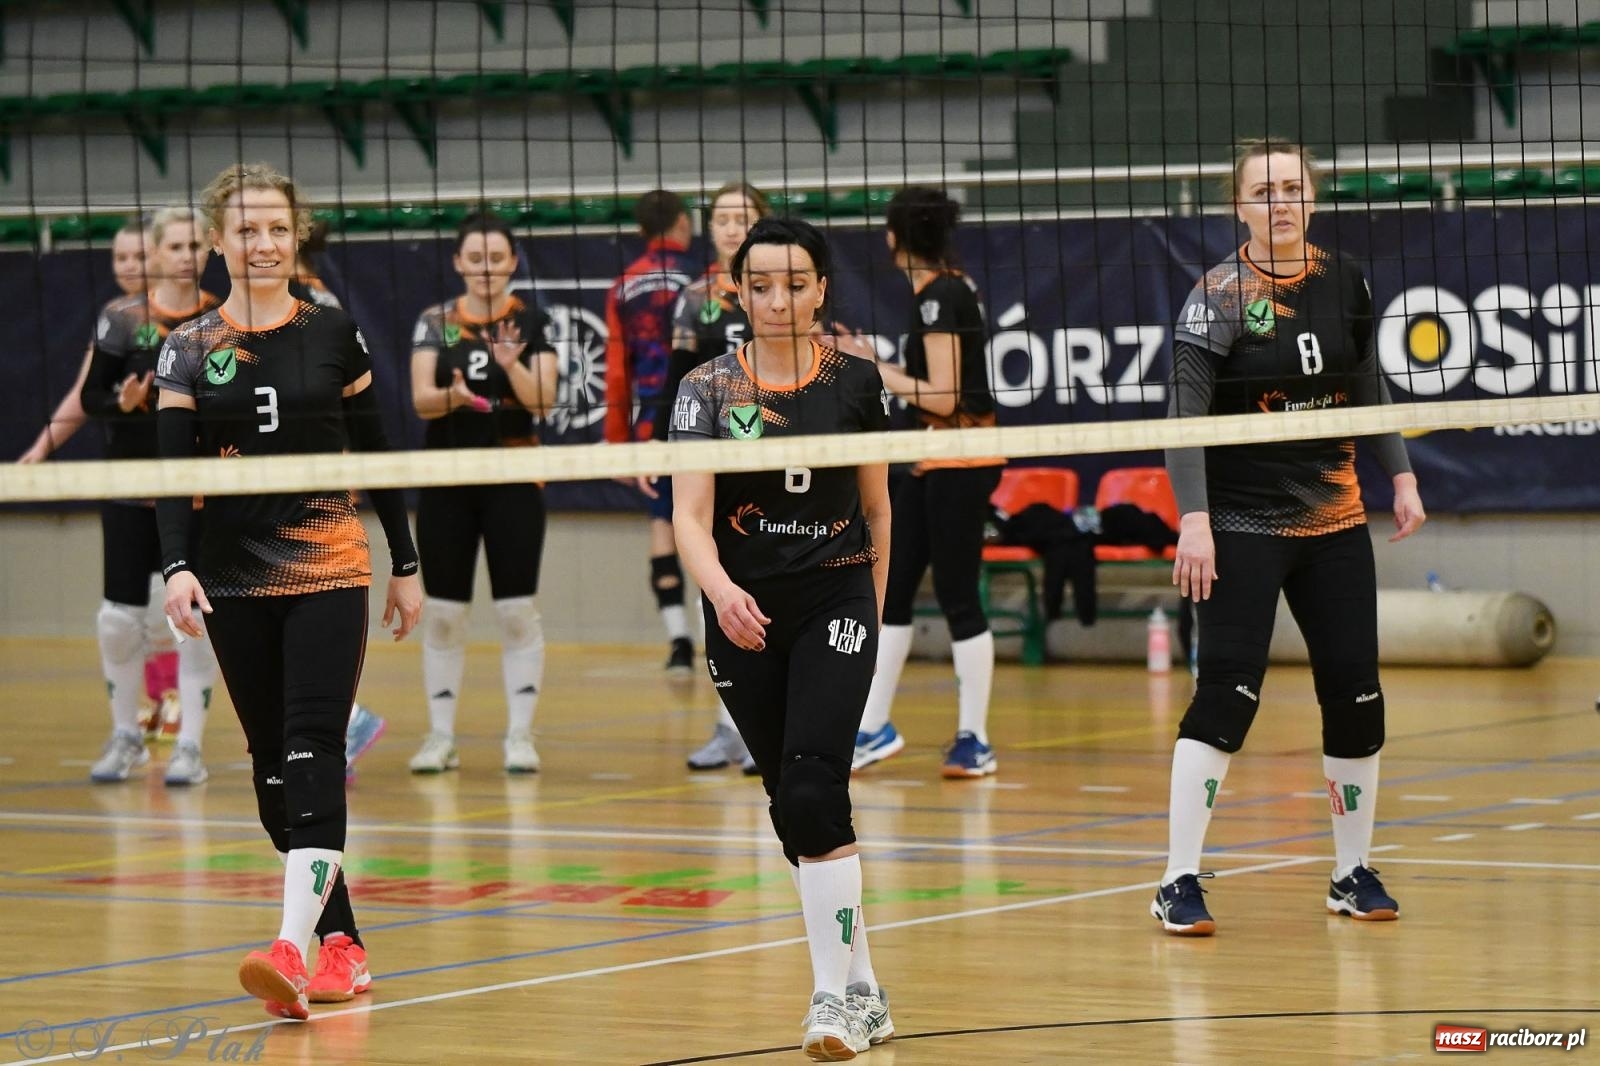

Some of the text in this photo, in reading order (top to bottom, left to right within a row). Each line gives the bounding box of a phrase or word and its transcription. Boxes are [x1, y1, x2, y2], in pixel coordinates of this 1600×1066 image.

[725, 324, 745, 352] 5
[1377, 283, 1600, 396] OSi
[468, 350, 489, 380] 2
[1297, 333, 1323, 375] 8
[254, 386, 279, 432] 3
[759, 518, 828, 539] Fundacja
[843, 617, 857, 636] TK
[709, 659, 718, 676] 6
